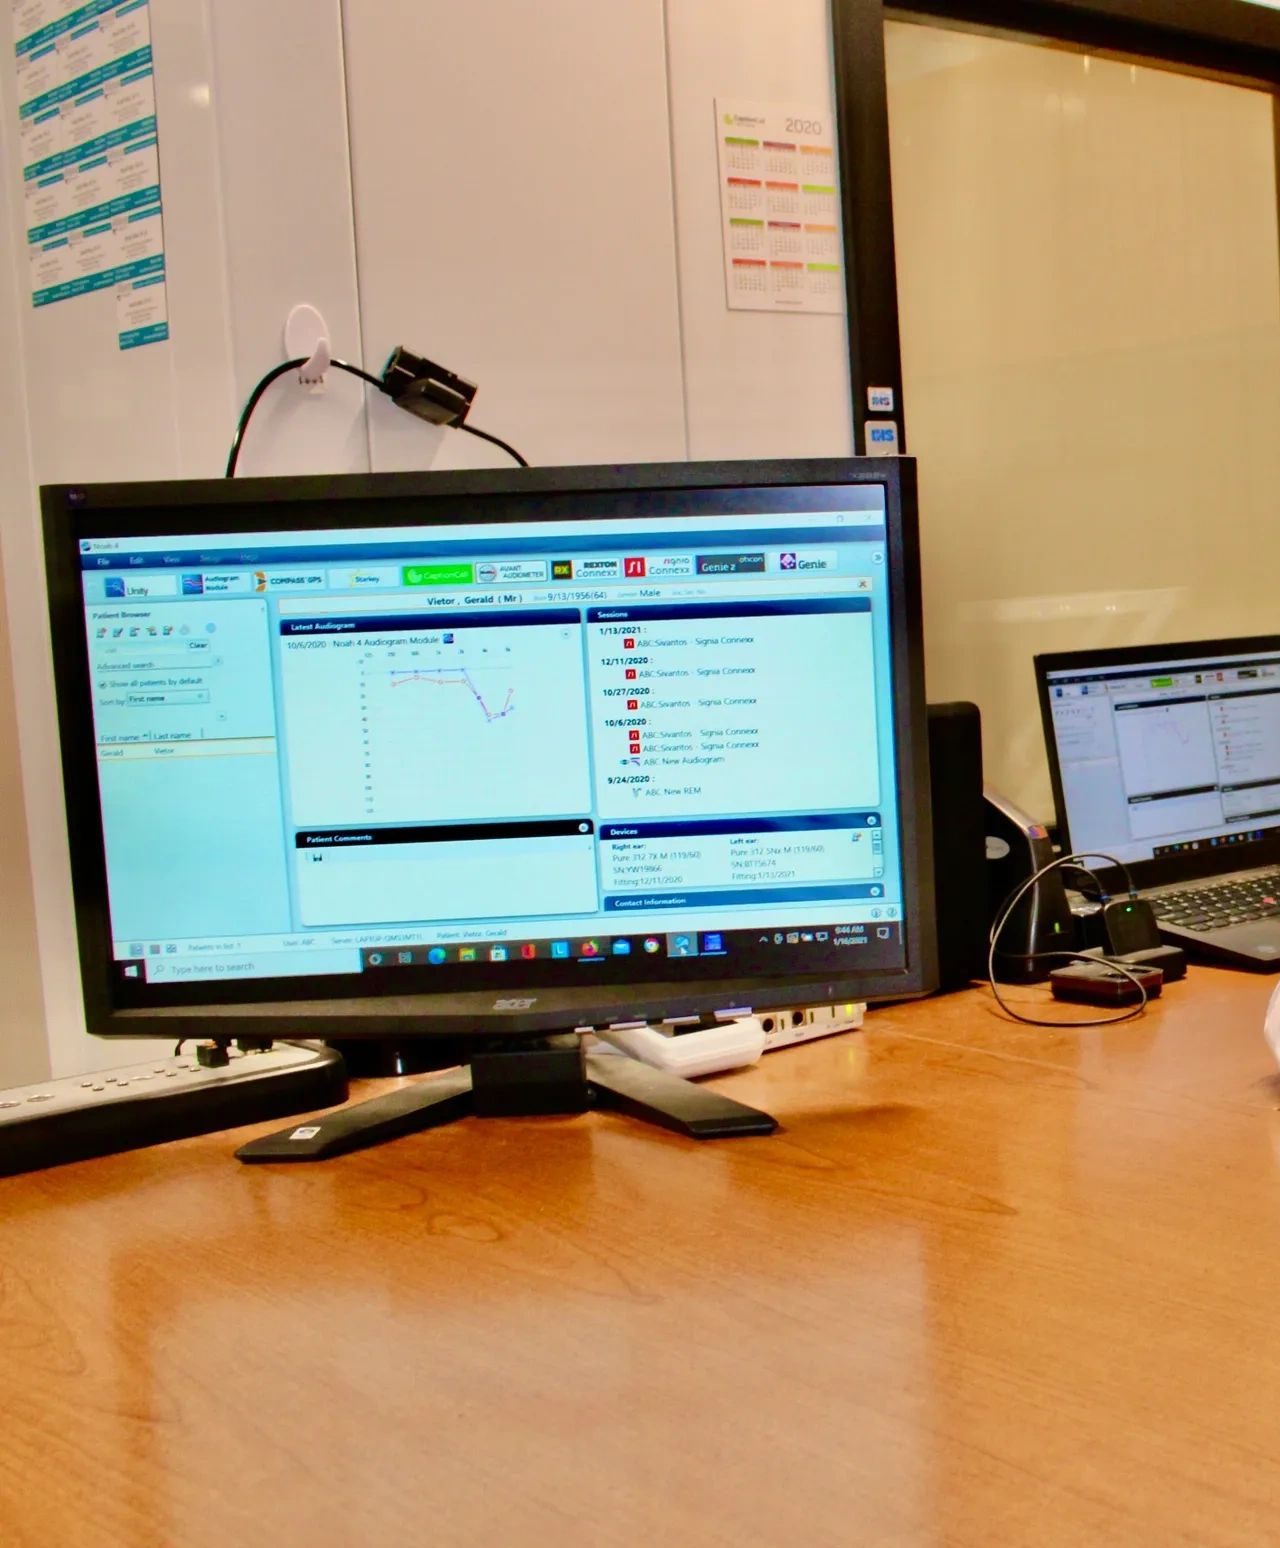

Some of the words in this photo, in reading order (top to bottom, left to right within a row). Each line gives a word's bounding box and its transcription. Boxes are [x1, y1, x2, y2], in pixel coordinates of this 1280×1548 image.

[785, 118, 822, 135] 2020
[97, 558, 110, 566] File
[130, 556, 144, 565] Edit
[162, 556, 180, 564] View
[798, 560, 827, 570] Genie
[554, 565, 569, 574] RX
[650, 566, 690, 576] Connexx
[701, 563, 729, 572] Genie
[503, 571, 544, 579] AUDIOMETER
[576, 568, 617, 578] Connexx
[205, 575, 240, 584] Audiogram
[270, 577, 304, 585] COMPASS
[308, 576, 322, 584] GPS
[355, 576, 380, 584] Starkey
[126, 587, 148, 597] Unity
[427, 598, 455, 606] Vietor
[464, 596, 494, 604] Gerald
[92, 612, 120, 620] Patient
[121, 611, 151, 619] Browser
[291, 622, 313, 630] Latest
[315, 622, 356, 631] Audiogram
[333, 640, 354, 648] Noah
[364, 638, 408, 648] Audiogram
[410, 636, 440, 645] Module
[601, 657, 648, 666] 12/11/2020
[602, 688, 650, 696] 10/27/2020
[129, 694, 144, 702] First
[604, 718, 646, 727] 10/6/2020
[682, 756, 724, 764] Audiogram
[608, 776, 650, 784] 9/24/2020
[610, 828, 638, 836] Devices
[306, 836, 332, 844] Patient
[334, 834, 372, 842] Comments
[615, 898, 642, 907] Contact
[644, 896, 686, 906] Information
[172, 965, 192, 975] Type
[216, 964, 224, 972] to
[227, 962, 255, 972] search
